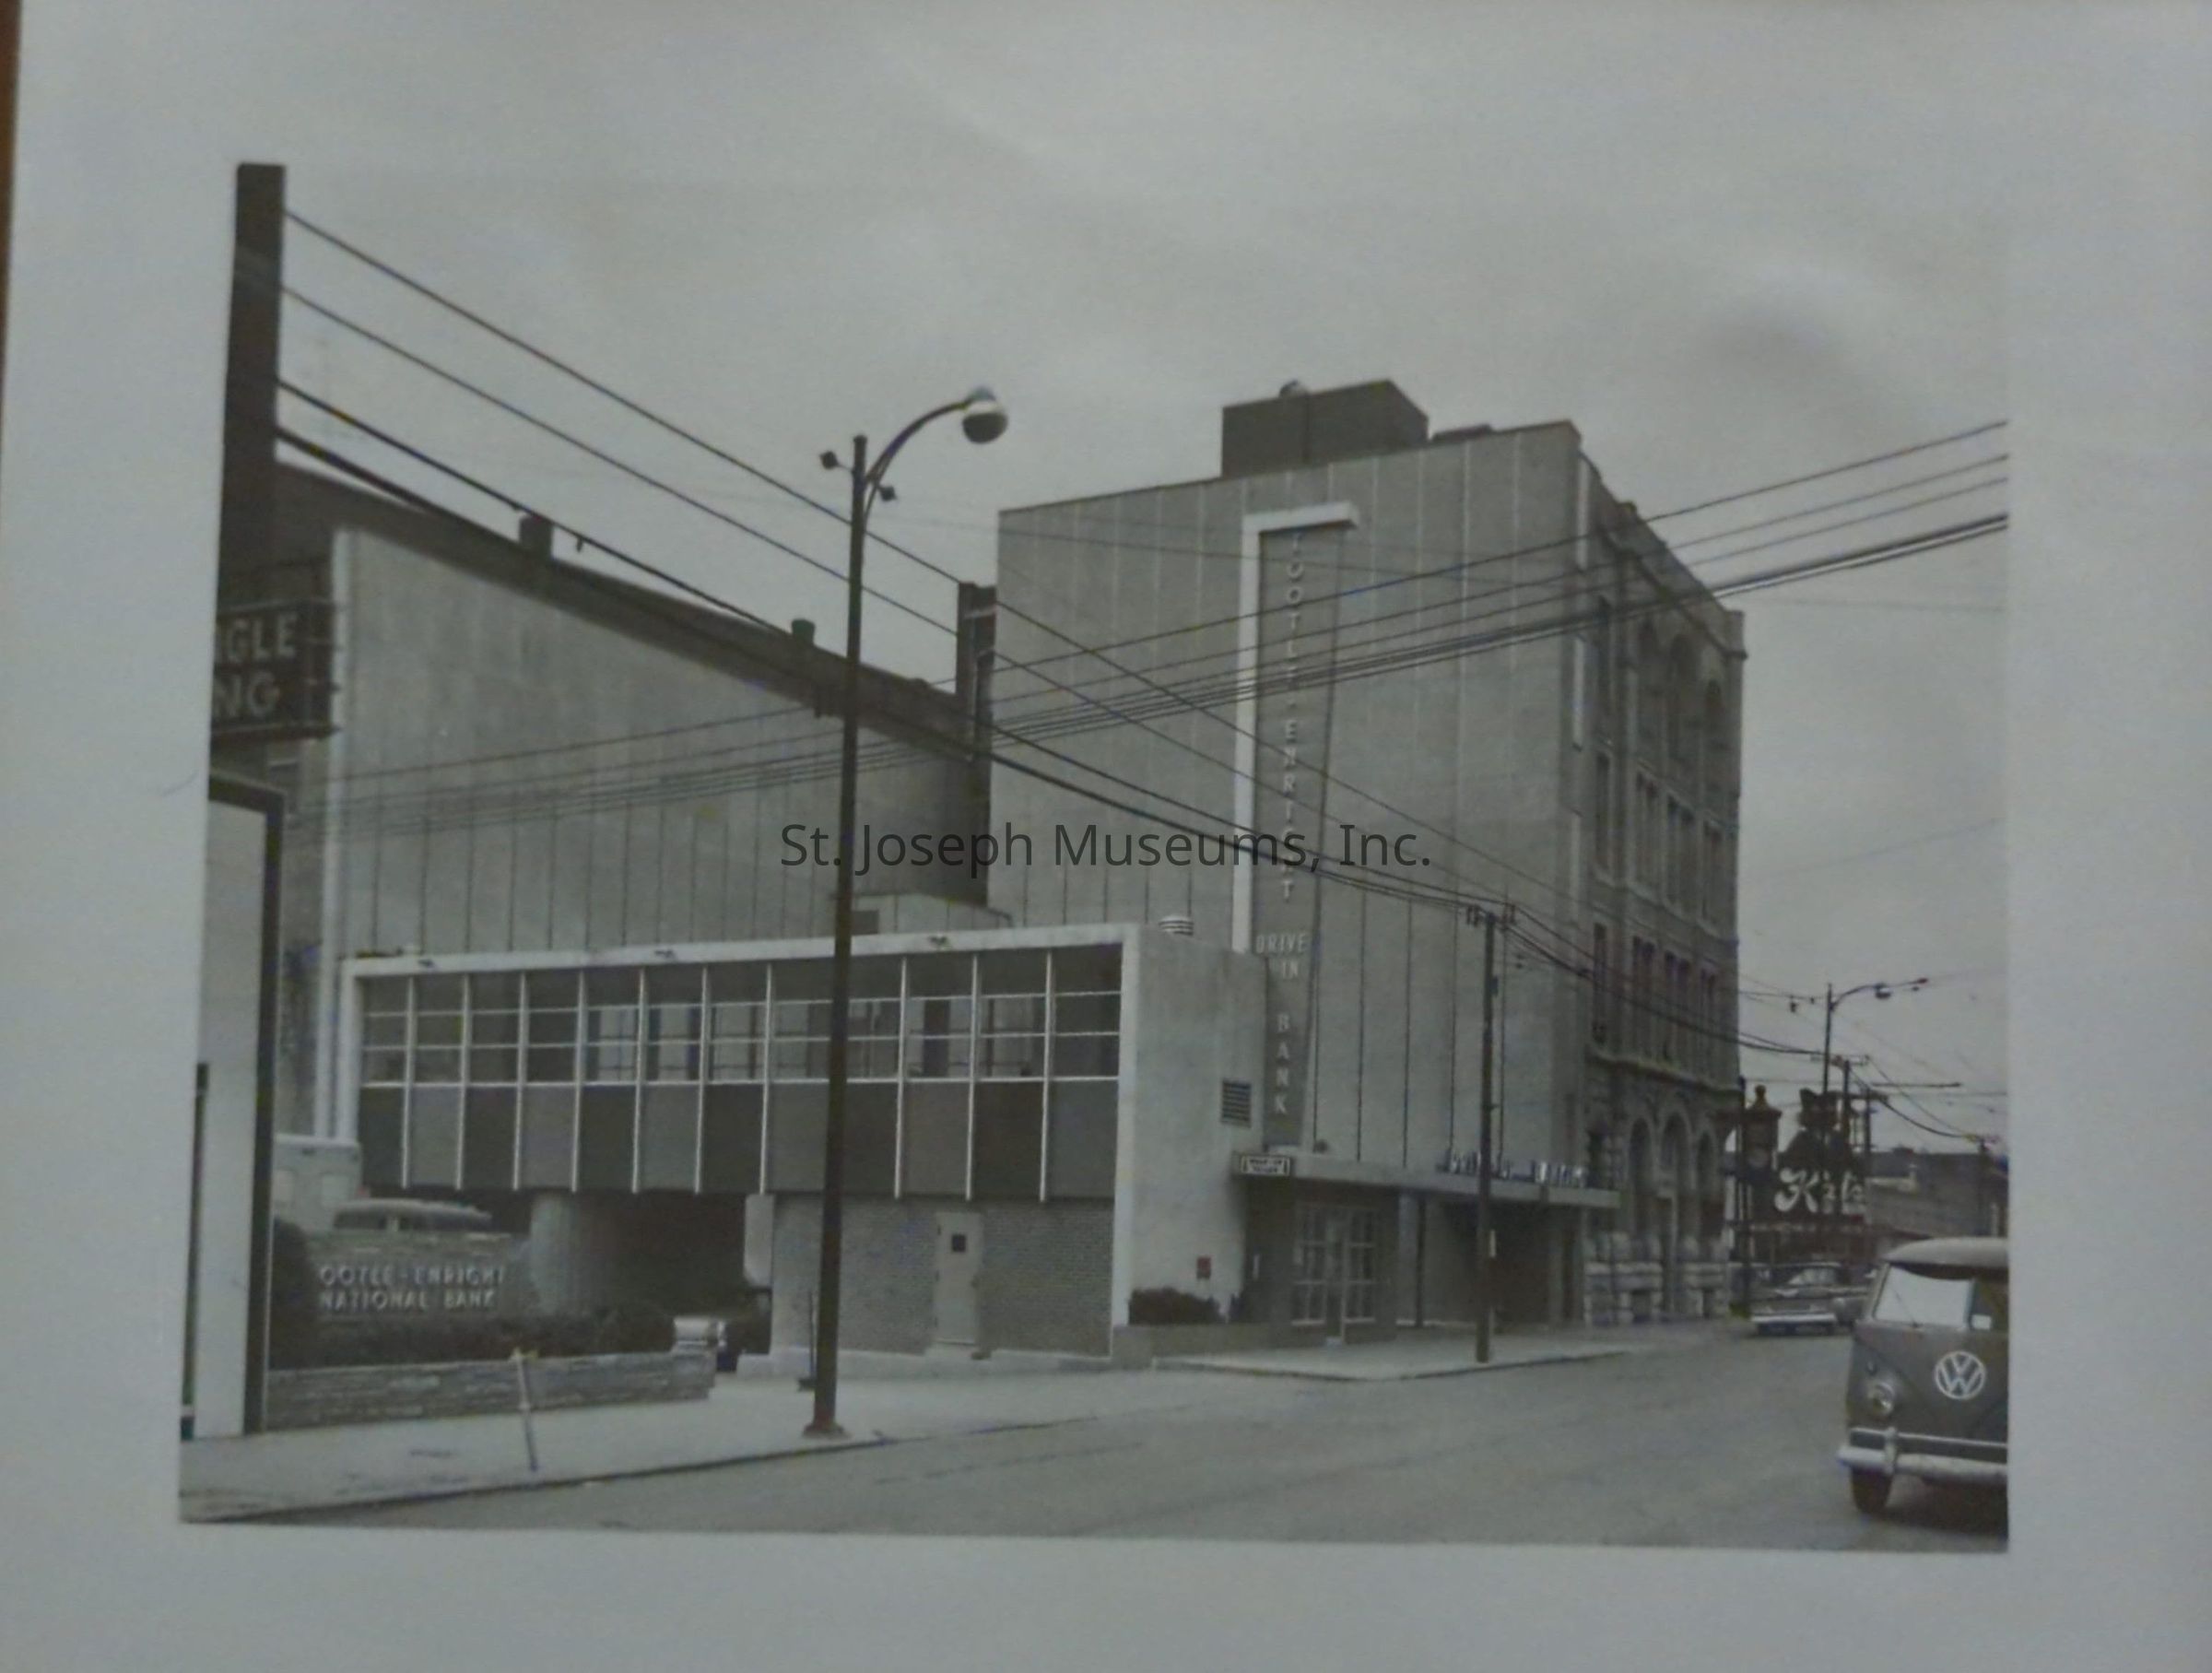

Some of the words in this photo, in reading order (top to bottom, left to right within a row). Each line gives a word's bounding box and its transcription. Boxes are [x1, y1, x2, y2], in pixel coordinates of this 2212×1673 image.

[1255, 933, 1307, 955] DRIVE
[1275, 1012, 1291, 1115] BANK
[318, 1265, 503, 1286] OOTLE-ENRIGHT
[320, 1289, 429, 1310] NATIONAL
[443, 1289, 496, 1309] BANK
[1936, 1351, 1985, 1399] VW
